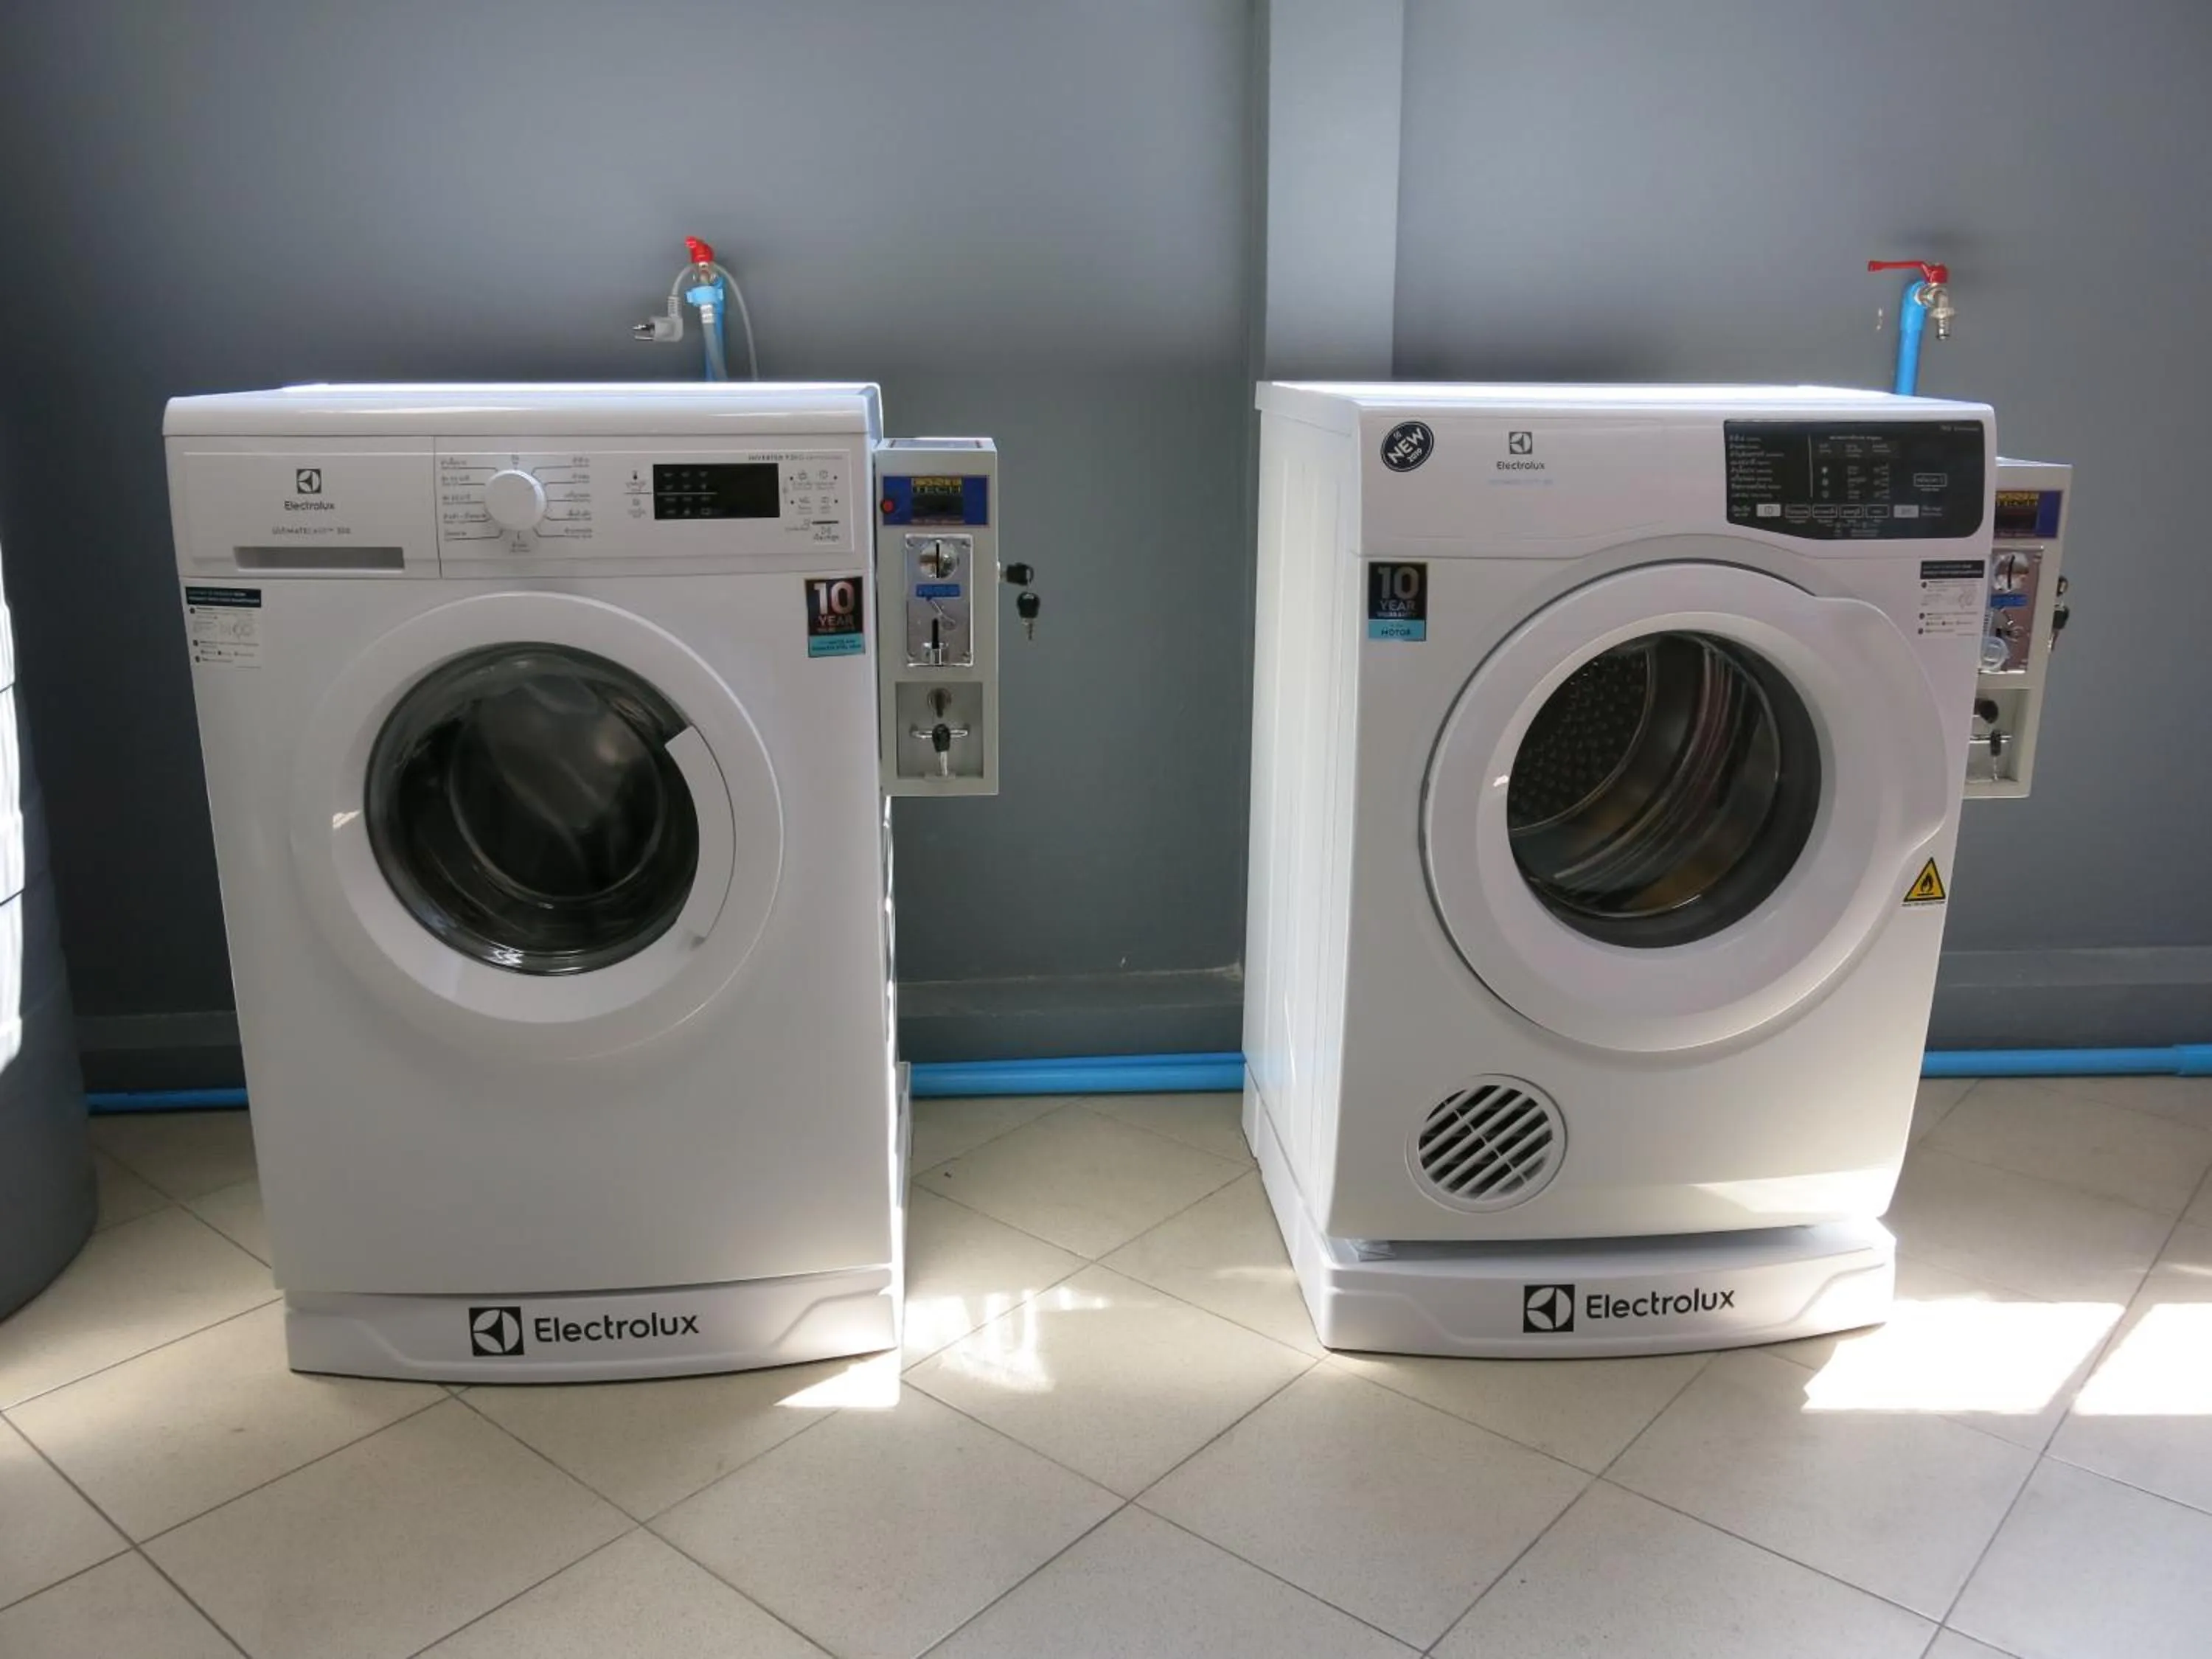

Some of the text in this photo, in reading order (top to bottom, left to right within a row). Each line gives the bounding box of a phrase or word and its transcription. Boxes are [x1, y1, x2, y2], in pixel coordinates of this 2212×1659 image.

[1387, 428, 1425, 464] NEW
[1496, 460, 1545, 470] Electrolux
[284, 501, 335, 511] Electrolux
[813, 580, 855, 615] 10
[1377, 566, 1419, 599] 10
[817, 614, 854, 627] YEAR
[1380, 599, 1416, 611] YEAR
[1585, 1287, 1735, 1319] Electrolux
[534, 1312, 700, 1343] Electrolux
